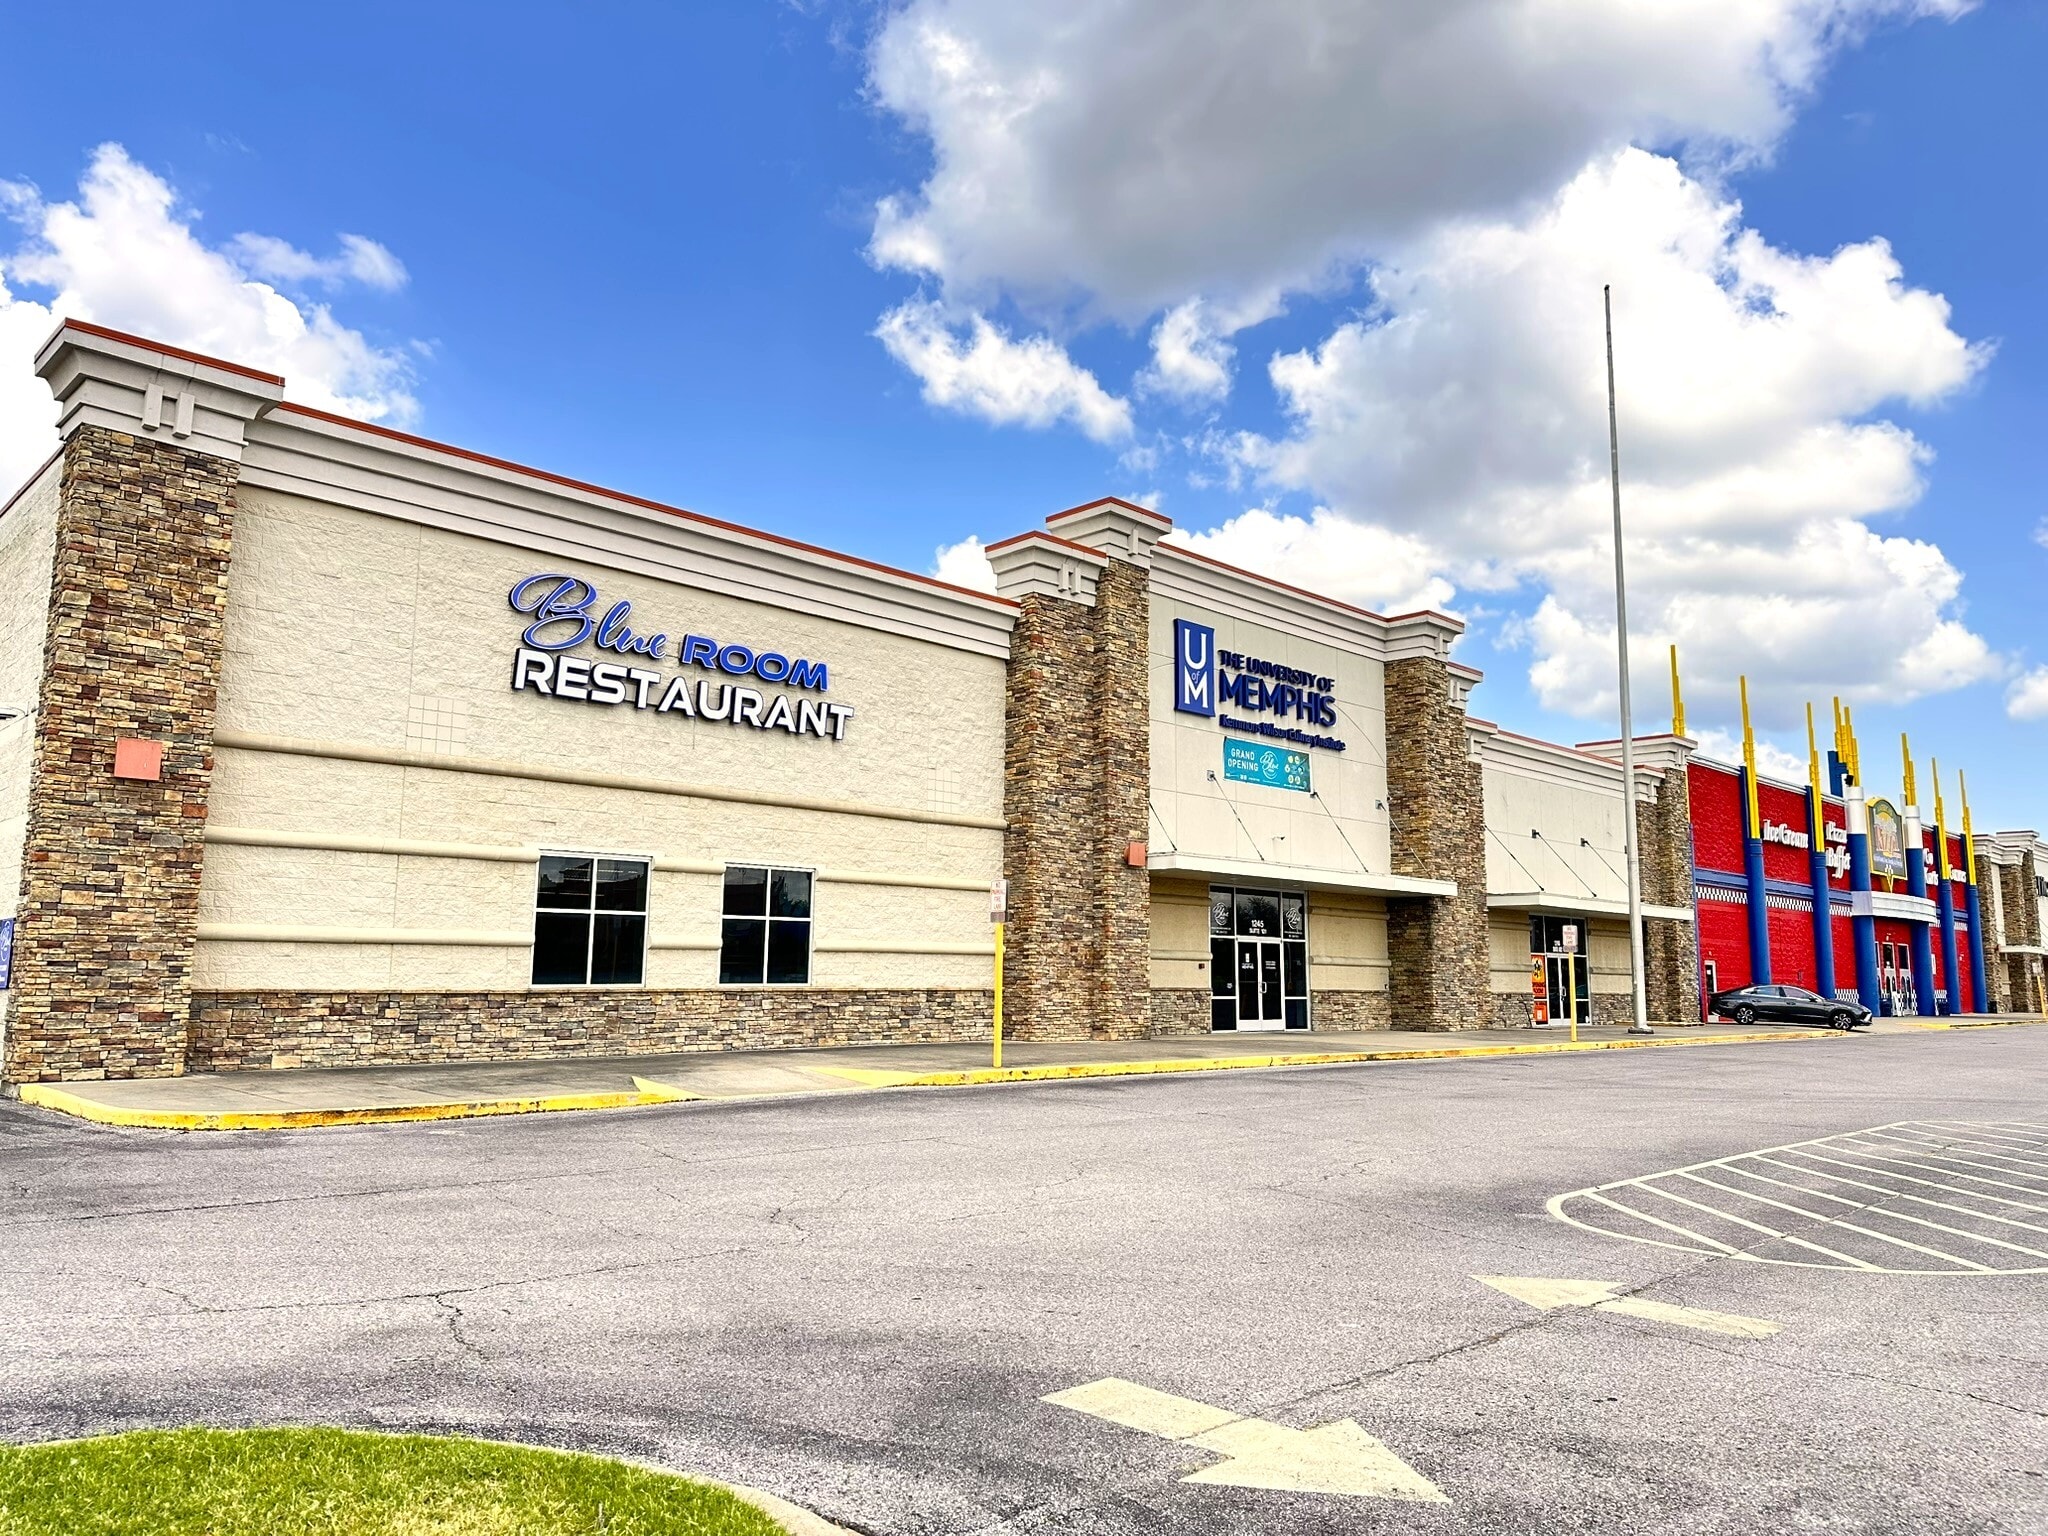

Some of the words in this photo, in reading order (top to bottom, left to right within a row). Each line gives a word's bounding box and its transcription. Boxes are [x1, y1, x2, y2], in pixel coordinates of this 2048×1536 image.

[509, 572, 668, 659] Blue
[680, 633, 829, 692] ROOM
[1184, 628, 1207, 670] U
[1184, 665, 1208, 708] M
[1191, 672, 1200, 683] of
[1218, 649, 1245, 670] THE
[1246, 656, 1317, 688] UNIVERSITY
[1316, 676, 1335, 692] OF
[513, 647, 854, 740] RESTAURANT
[1219, 668, 1337, 727] MEMPHIS
[1230, 747, 1255, 760] GRAND
[1260, 722, 1288, 738] Wilson
[1286, 728, 1317, 748] Culinary
[1227, 758, 1259, 771] OPENING
[1763, 819, 1779, 842] Ice
[1778, 823, 1809, 848] Cream
